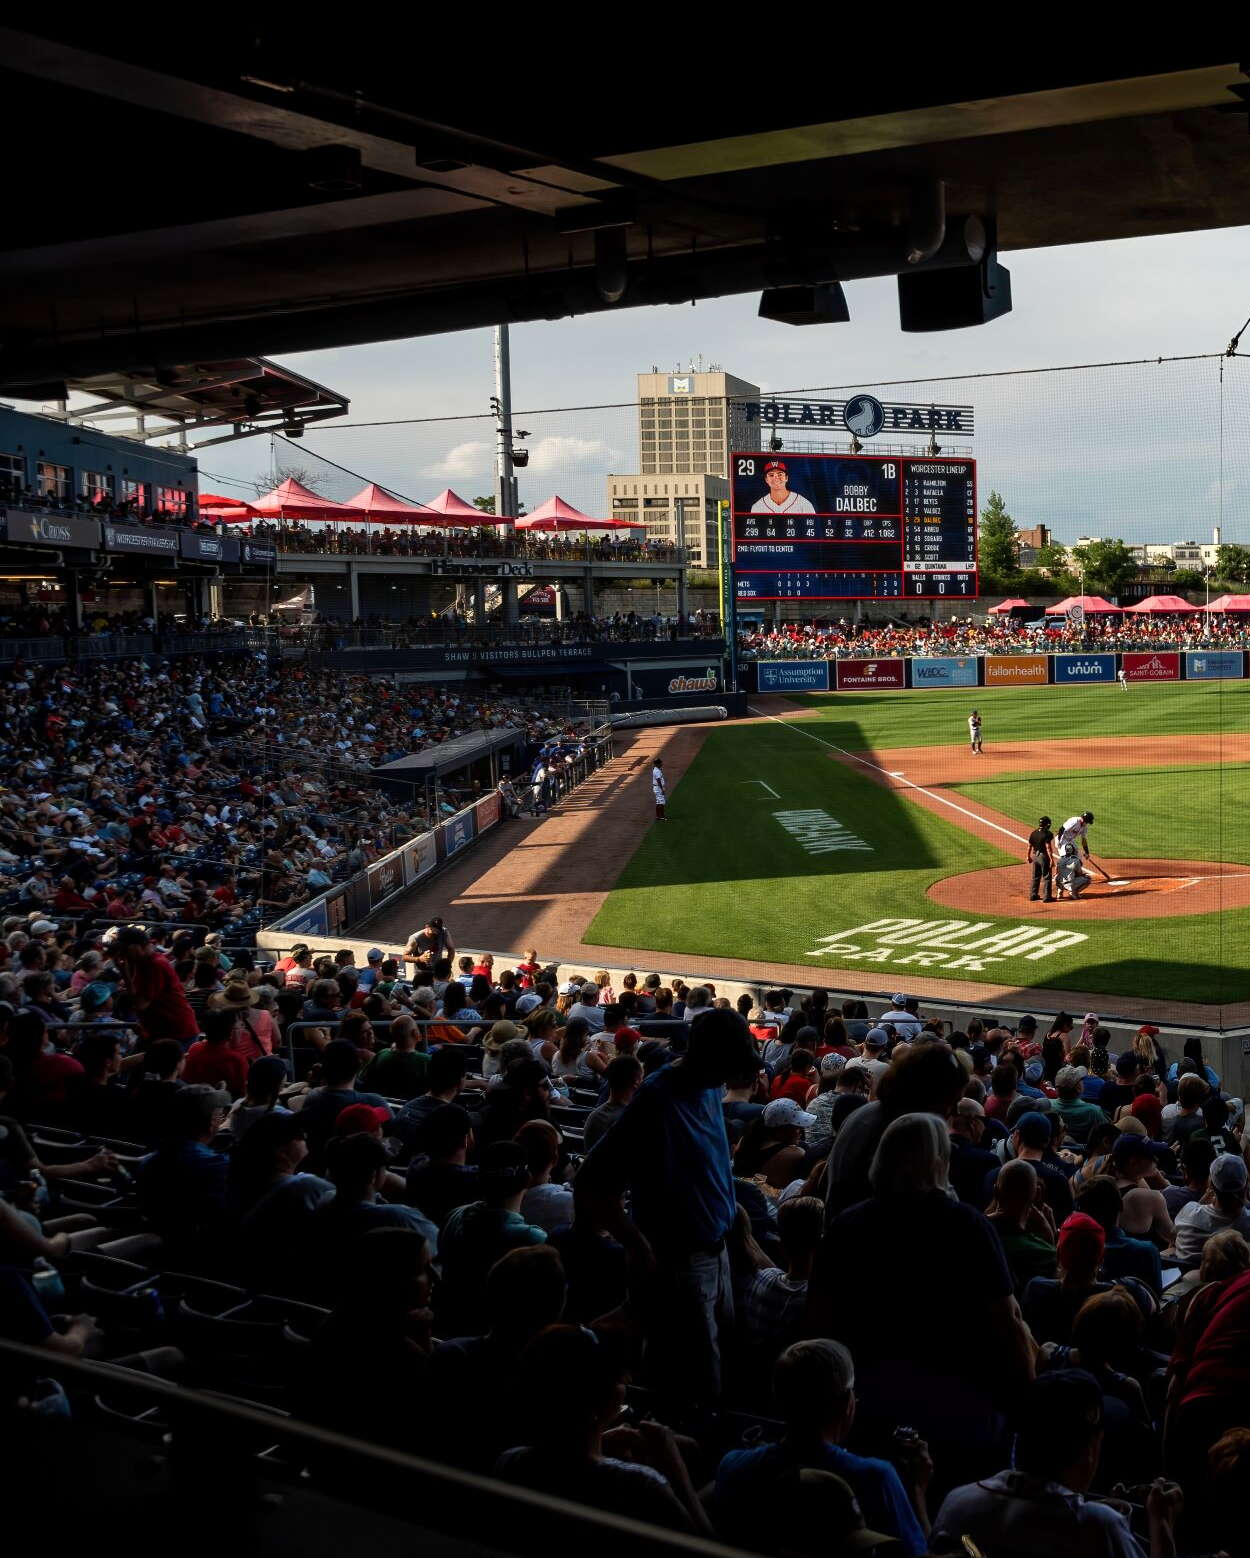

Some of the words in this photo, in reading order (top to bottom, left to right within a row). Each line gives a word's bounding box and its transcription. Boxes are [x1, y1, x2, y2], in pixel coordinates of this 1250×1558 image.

[745, 402, 836, 424] POLAR
[892, 407, 963, 430] PARK
[738, 459, 755, 476] 29
[882, 464, 896, 479] 1B
[911, 464, 945, 473] WORCESTER
[946, 466, 967, 474] LINEUP
[844, 485, 868, 496] BOBBY
[836, 498, 877, 512] DALBEC
[767, 528, 776, 537] 64
[786, 528, 796, 537] 20
[806, 529, 815, 537] 45
[826, 529, 834, 537] 52
[845, 529, 853, 537] 32
[502, 562, 532, 575] Deck
[916, 582, 922, 594] 0
[939, 582, 944, 594] 0
[961, 582, 965, 594] 1
[480, 651, 519, 660] VISITORS
[522, 650, 556, 658] BULLPEN
[559, 648, 592, 656] TERRACE
[779, 667, 823, 677] Assumption
[988, 665, 1045, 677] fallonhealth
[1067, 662, 1102, 675] unum
[1129, 669, 1174, 677] SAINT-GOBAIN
[778, 676, 816, 685] University
[816, 918, 1090, 961] POLAR
[804, 943, 1008, 971] PARK
